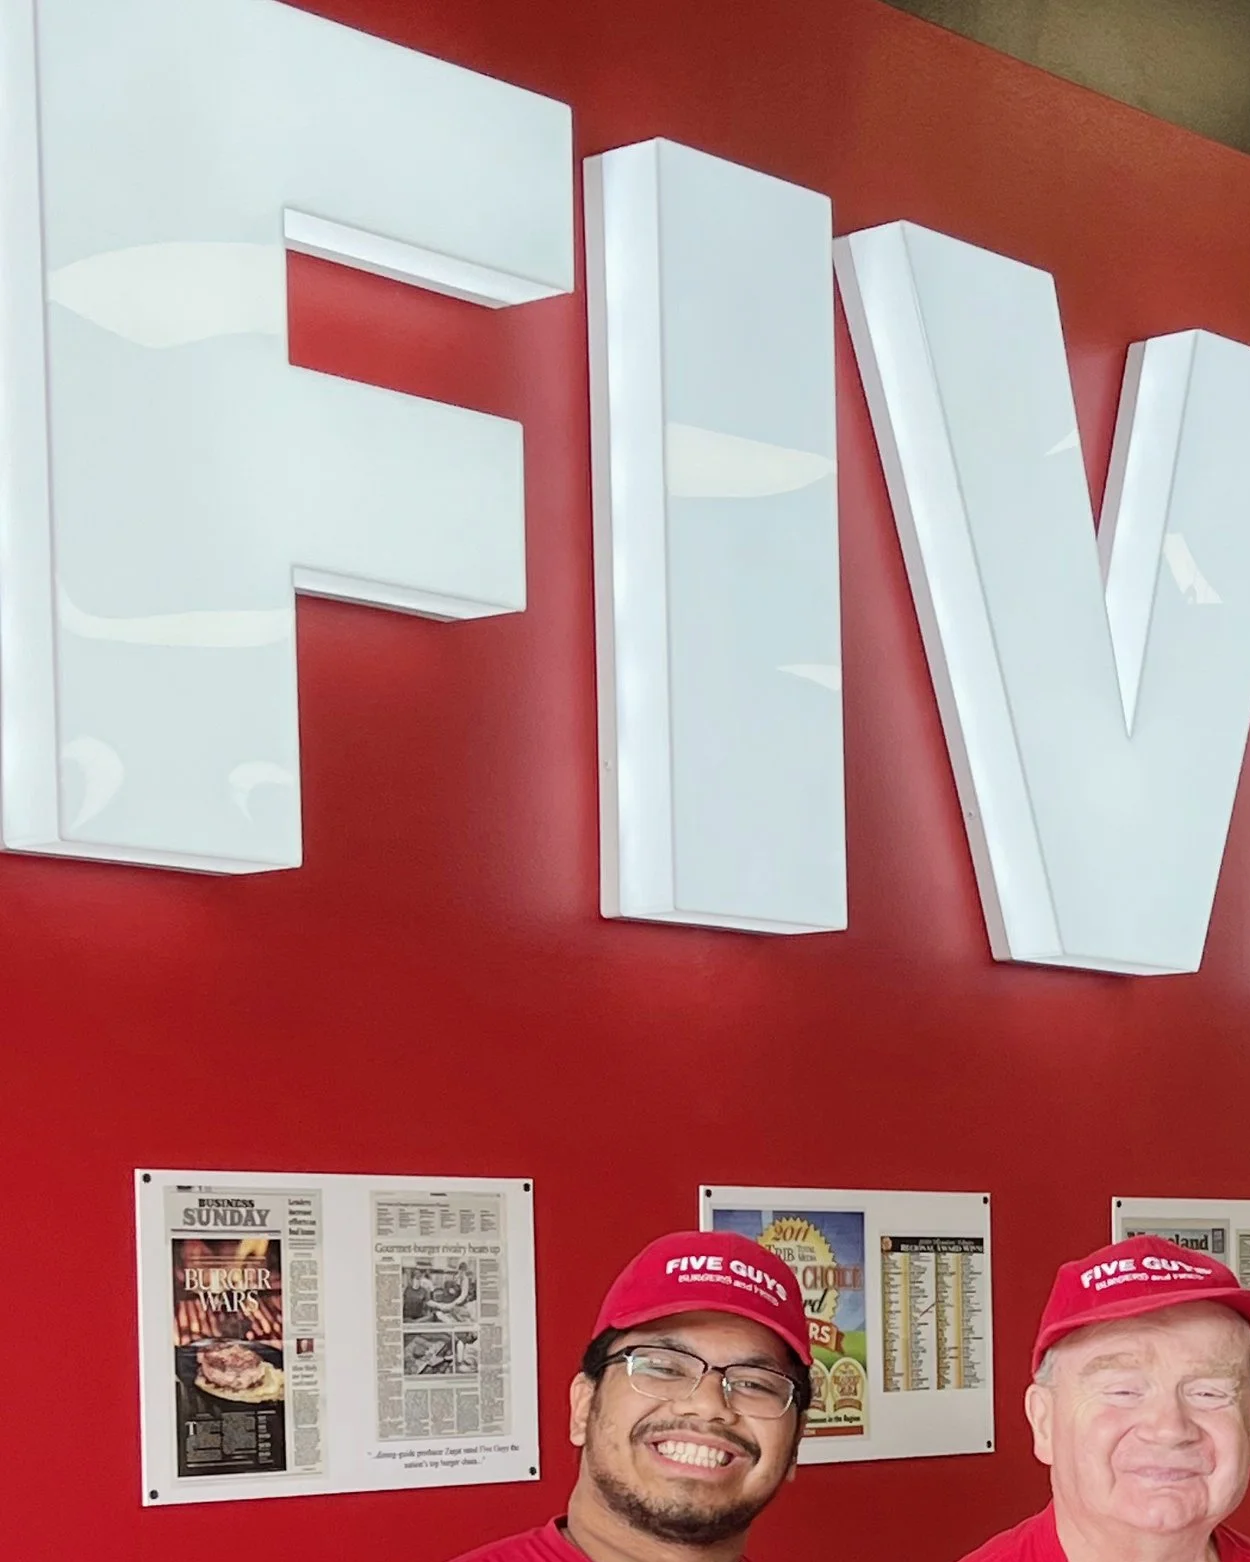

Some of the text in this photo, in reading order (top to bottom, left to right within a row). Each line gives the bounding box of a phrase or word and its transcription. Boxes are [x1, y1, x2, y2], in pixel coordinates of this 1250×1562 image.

[198, 1198, 255, 1208] BUSINESS
[183, 1208, 271, 1227] SUNDAY
[772, 1226, 809, 1241] 2011
[184, 1268, 271, 1291] BURGER
[666, 1256, 724, 1274] FIVE
[730, 1260, 788, 1302] GUYS
[802, 1265, 863, 1291] CHOICE
[1080, 1257, 1136, 1288] FIVE
[1142, 1256, 1212, 1276] GUYS
[198, 1290, 259, 1313] WARS
